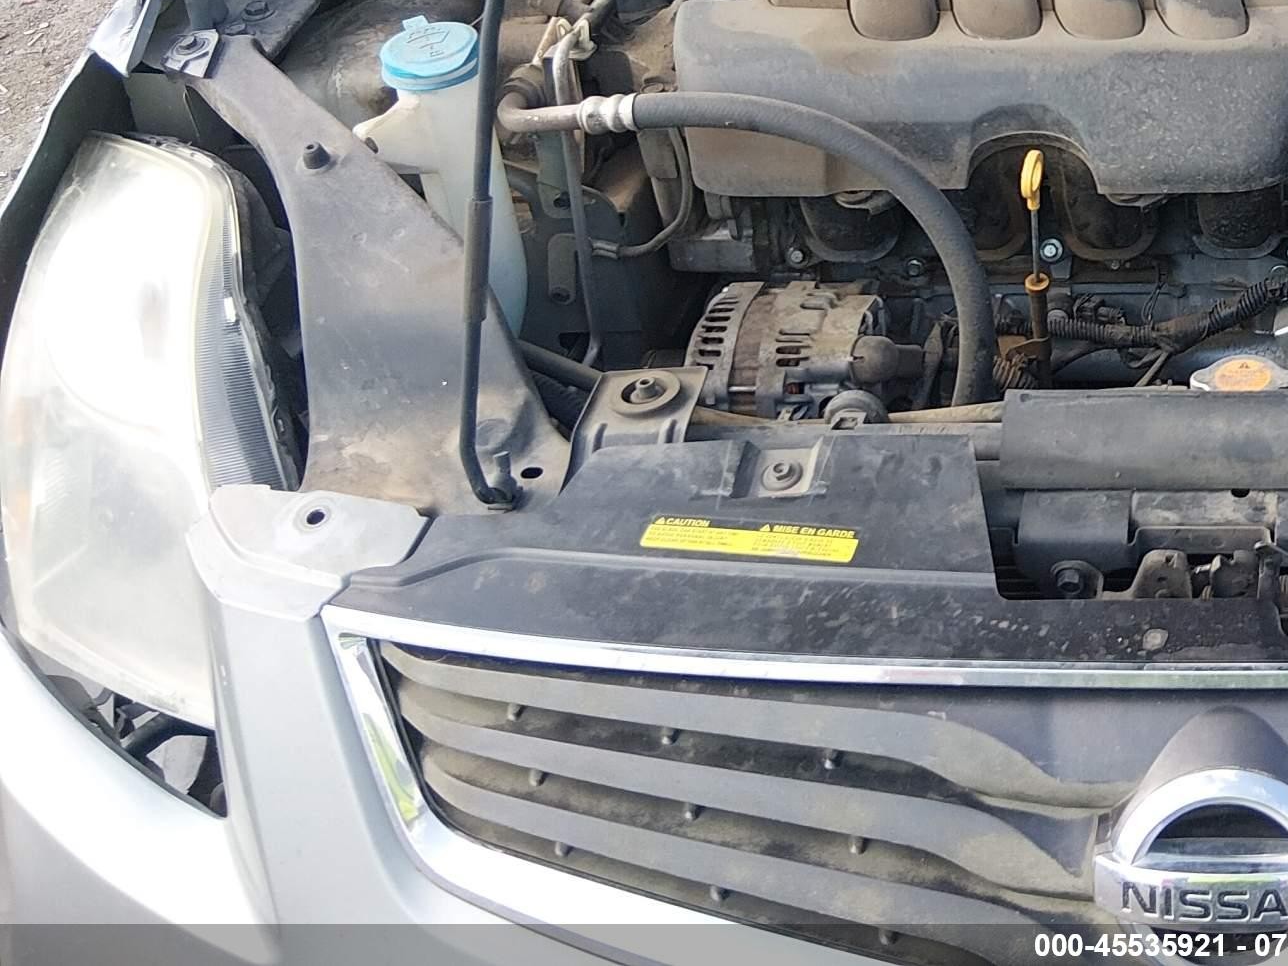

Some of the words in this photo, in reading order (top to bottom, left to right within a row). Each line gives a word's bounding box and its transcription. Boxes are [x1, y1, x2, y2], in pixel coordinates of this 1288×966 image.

[665, 517, 711, 528] CAUTION
[772, 524, 800, 534] MISE
[800, 526, 816, 536] EN
[817, 528, 856, 539] GARDE
